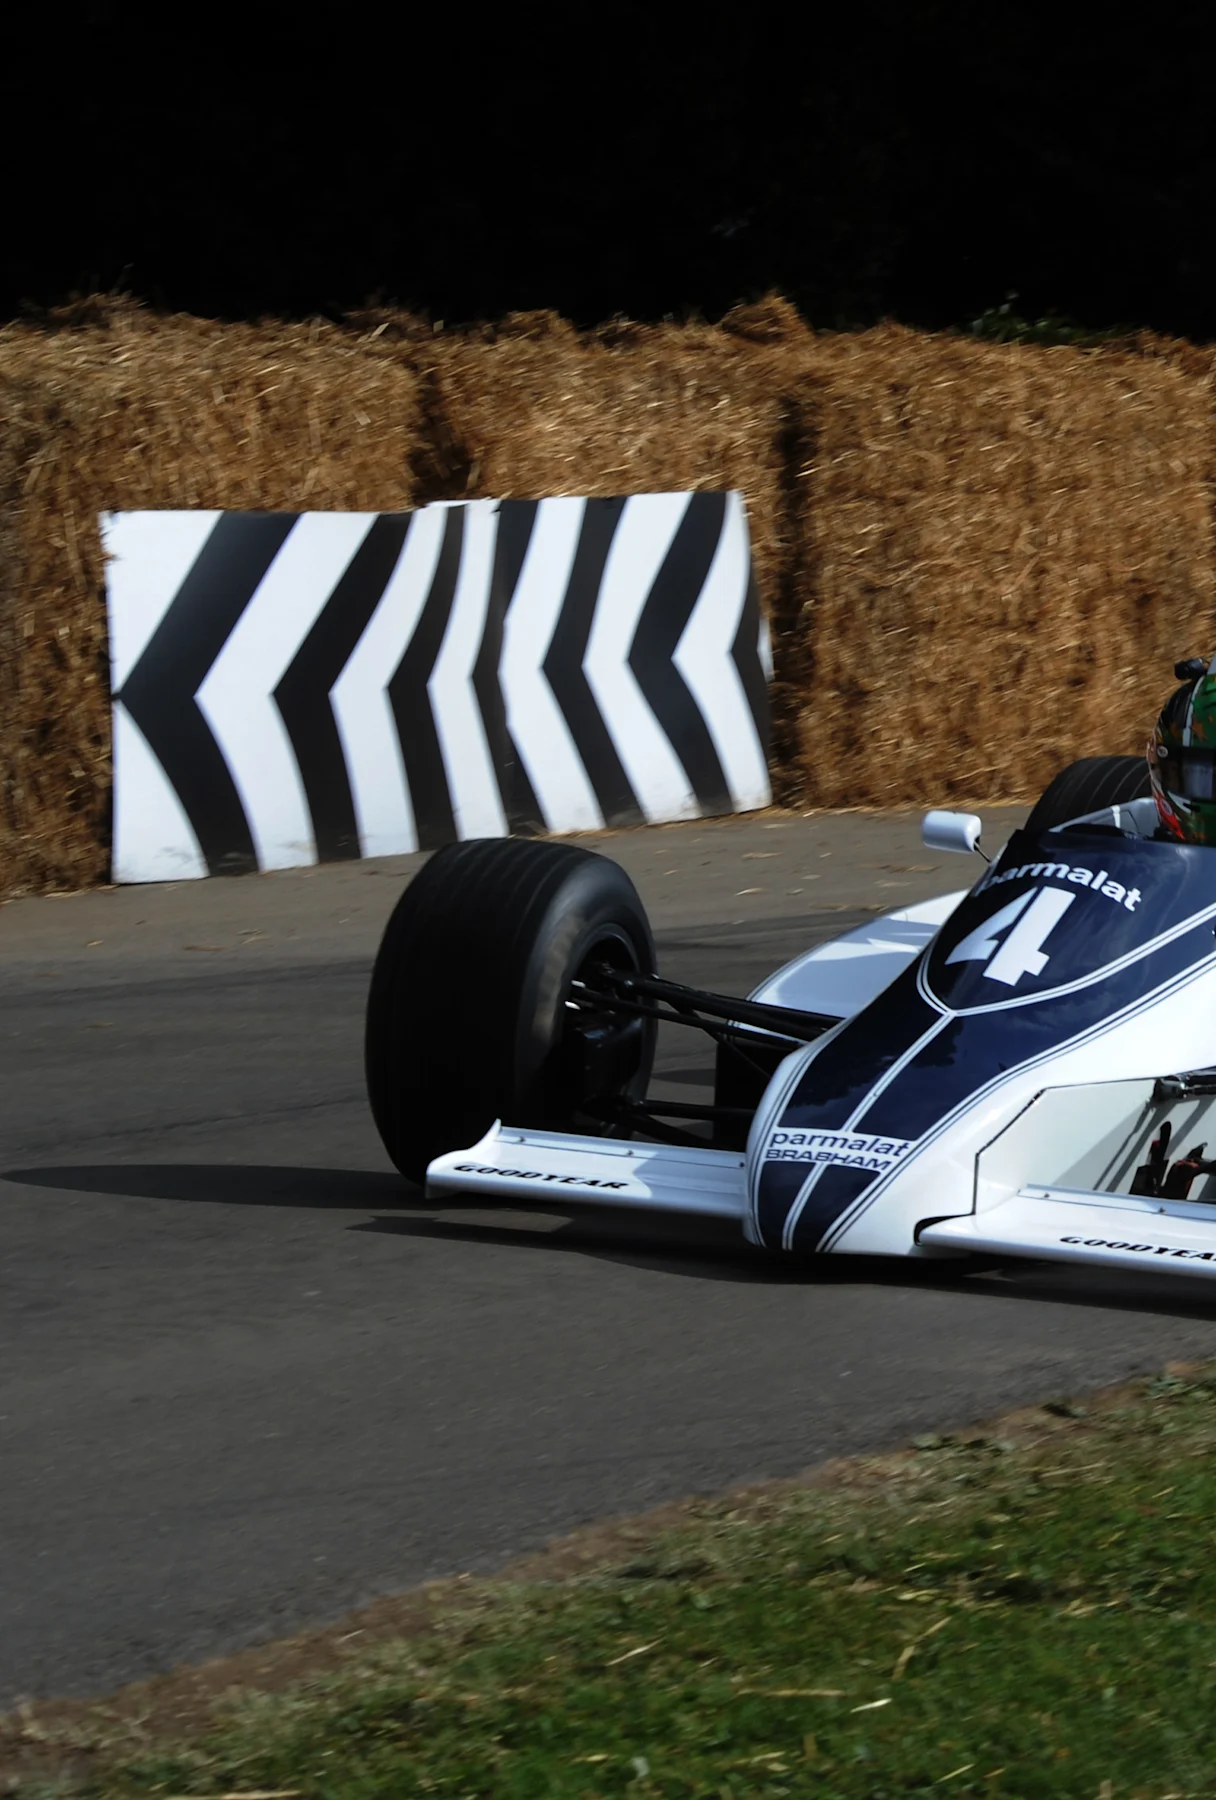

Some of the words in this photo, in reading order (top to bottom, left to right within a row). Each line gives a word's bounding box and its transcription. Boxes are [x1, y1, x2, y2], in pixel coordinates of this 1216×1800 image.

[945, 886, 1077, 987] 4
[769, 1132, 911, 1157] parmalat
[765, 1149, 893, 1172] BRABHAM
[453, 1164, 629, 1190] GOODYEAR
